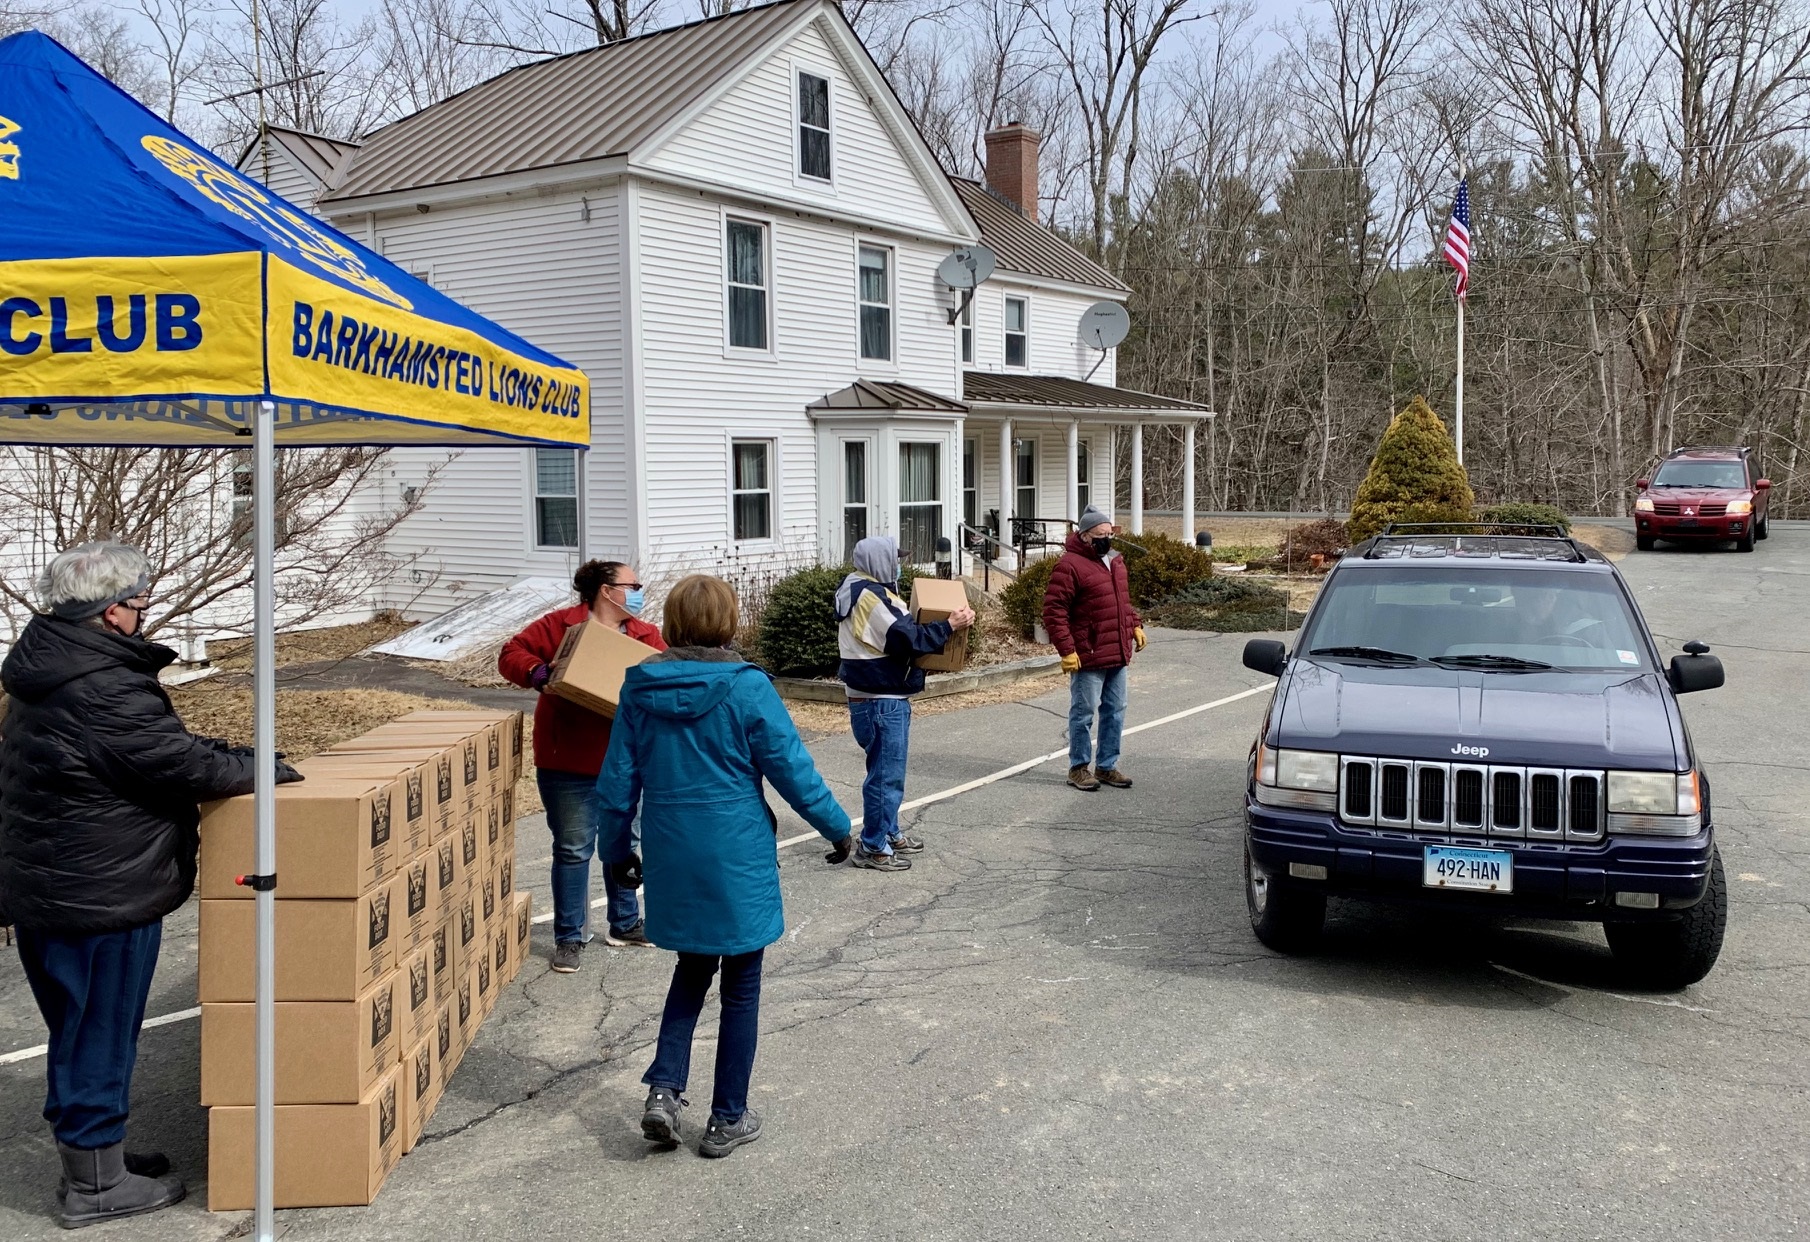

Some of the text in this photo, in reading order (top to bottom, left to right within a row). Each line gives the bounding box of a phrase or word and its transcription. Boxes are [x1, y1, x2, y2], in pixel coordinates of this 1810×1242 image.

[0, 293, 203, 356] CLUB
[292, 300, 581, 419] BARKHAMSTED LIONS CLUB
[1450, 742, 1490, 759] Jeep
[1449, 849, 1489, 859] Connecticut
